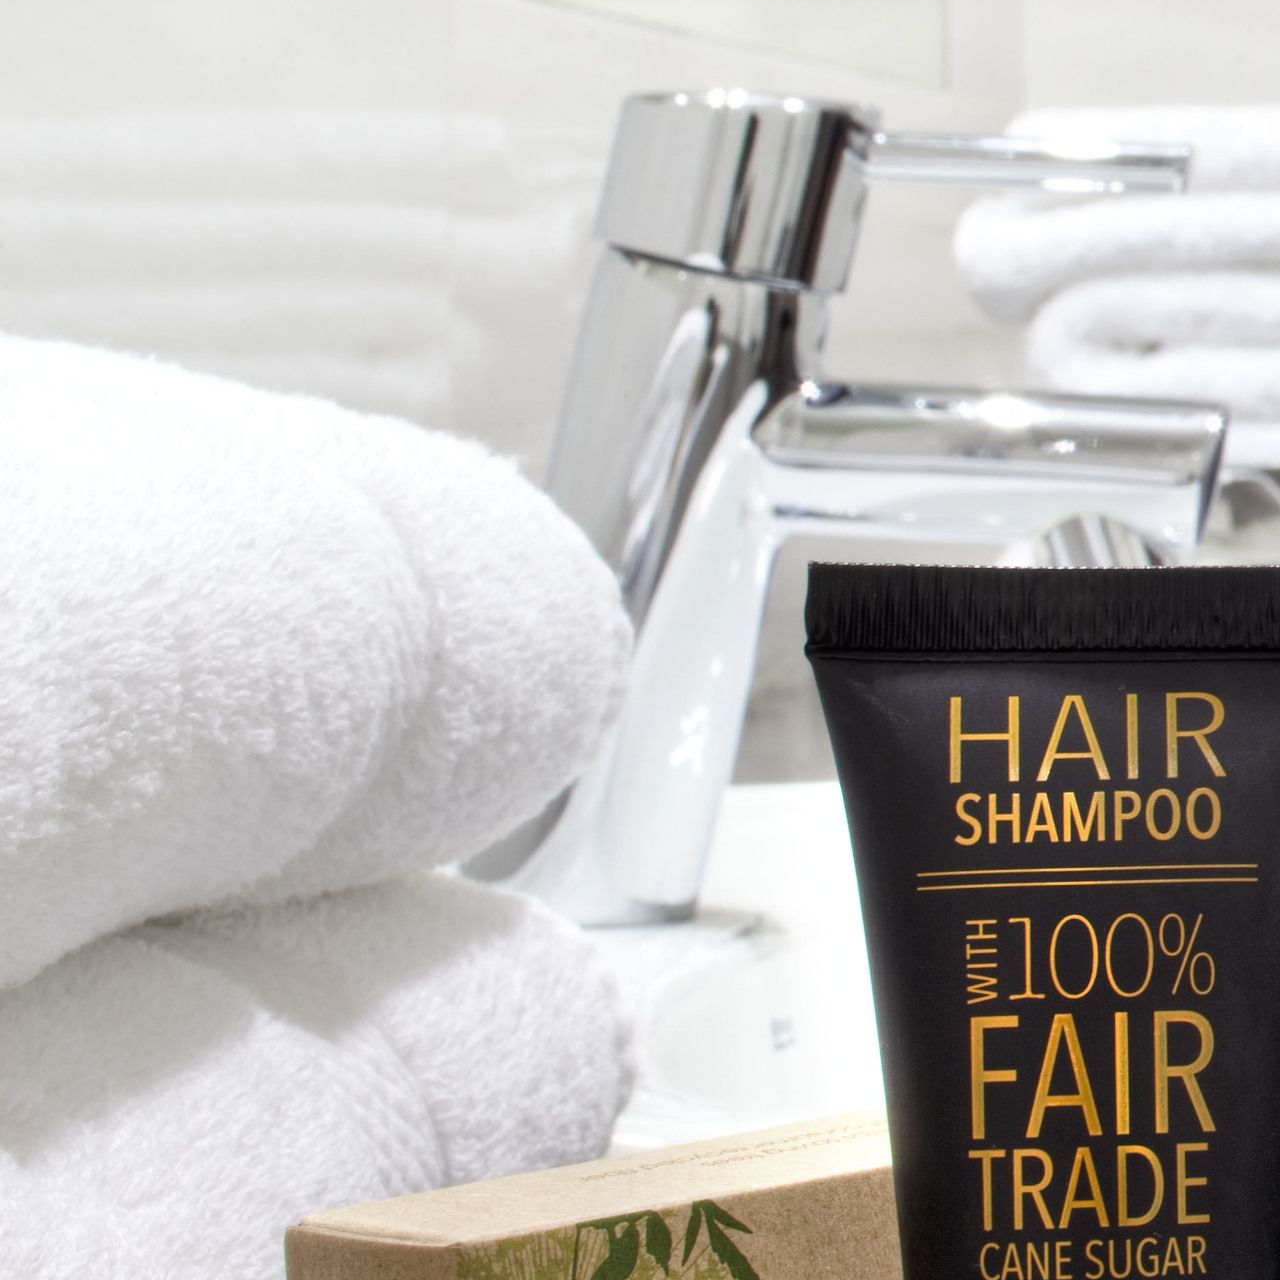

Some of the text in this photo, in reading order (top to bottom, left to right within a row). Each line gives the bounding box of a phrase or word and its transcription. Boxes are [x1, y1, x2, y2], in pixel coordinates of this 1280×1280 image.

[950, 693, 1225, 783] HAIR
[955, 788, 1220, 845] SHAMPOO
[966, 913, 1214, 1004] WITH 100%
[970, 1011, 1216, 1139] FAIR
[968, 1143, 1210, 1231] TRADE
[1086, 1236, 1206, 1279] SUGAR
